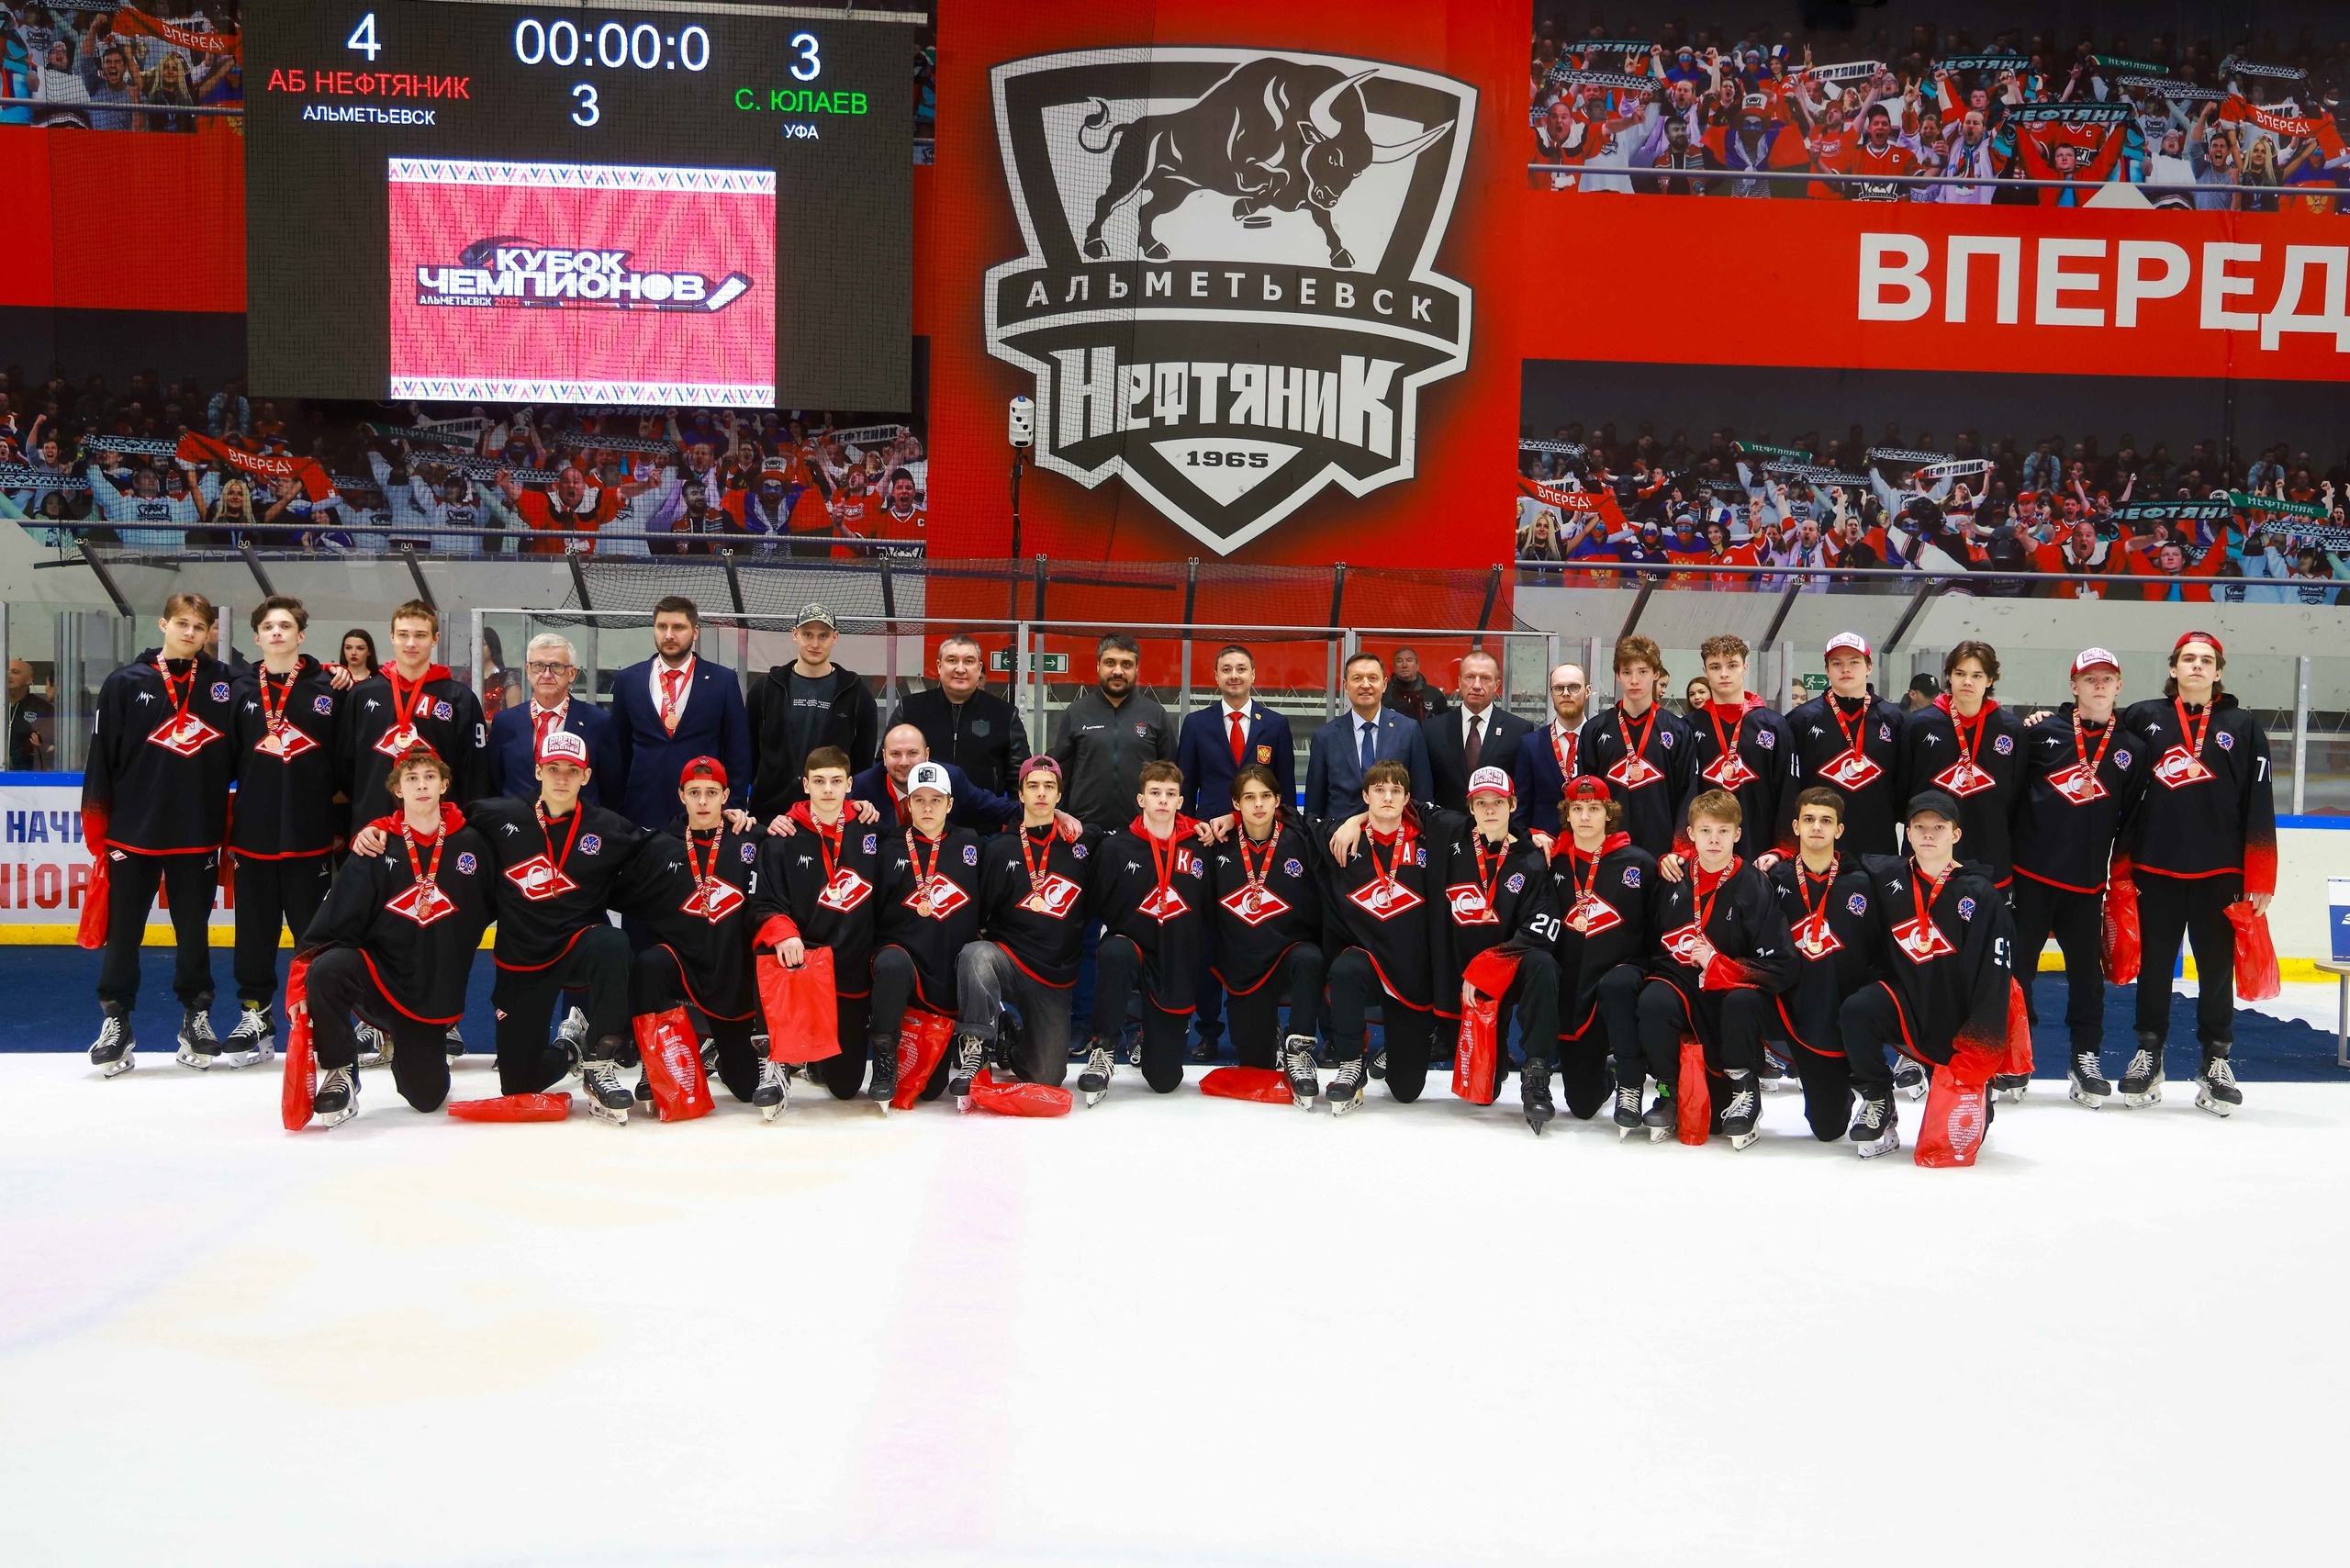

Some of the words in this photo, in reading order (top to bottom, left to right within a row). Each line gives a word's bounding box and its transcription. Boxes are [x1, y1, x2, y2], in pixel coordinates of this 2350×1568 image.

[162, 24, 225, 51] ВПЕРЕД!
[347, 13, 382, 62] 4
[515, 19, 711, 72] 00:00:0
[790, 33, 822, 81] 3
[1809, 62, 1875, 80] НЕФТЯНИК
[268, 69, 307, 93] АБ
[315, 71, 470, 100] НЕФТЯНИК
[571, 84, 600, 127] 3
[735, 88, 762, 111] С.
[771, 89, 868, 115] ЮЛАЕВ
[303, 106, 436, 126] АЛЬМЕТЬЕВСК
[2255, 109, 2311, 135] ВПЕРЕД!
[784, 124, 820, 140] УФА
[496, 248, 628, 274] КУБОК
[419, 266, 707, 301] ЧЕМПИОНОВ
[1857, 231, 2350, 353] ВПЕРЕД
[420, 295, 492, 307] АЛЬМЕТЬЕВСК
[1025, 271, 1433, 323] АЛЬМЕТЬЕВСК
[831, 427, 899, 443] НЕФТЯНИК
[228, 448, 292, 474] ВПЕРЕД!
[1186, 450, 1270, 469] 1965
[1923, 461, 1984, 476] НЕФТЯНИК
[1537, 485, 1592, 510] ВПЕРЕД!
[2247, 497, 2314, 514] НЕФТЯНИК
[549, 735, 582, 746] СПАРТАК
[1474, 767, 1503, 778] СПАРТАК
[1529, 913, 1561, 943] 20
